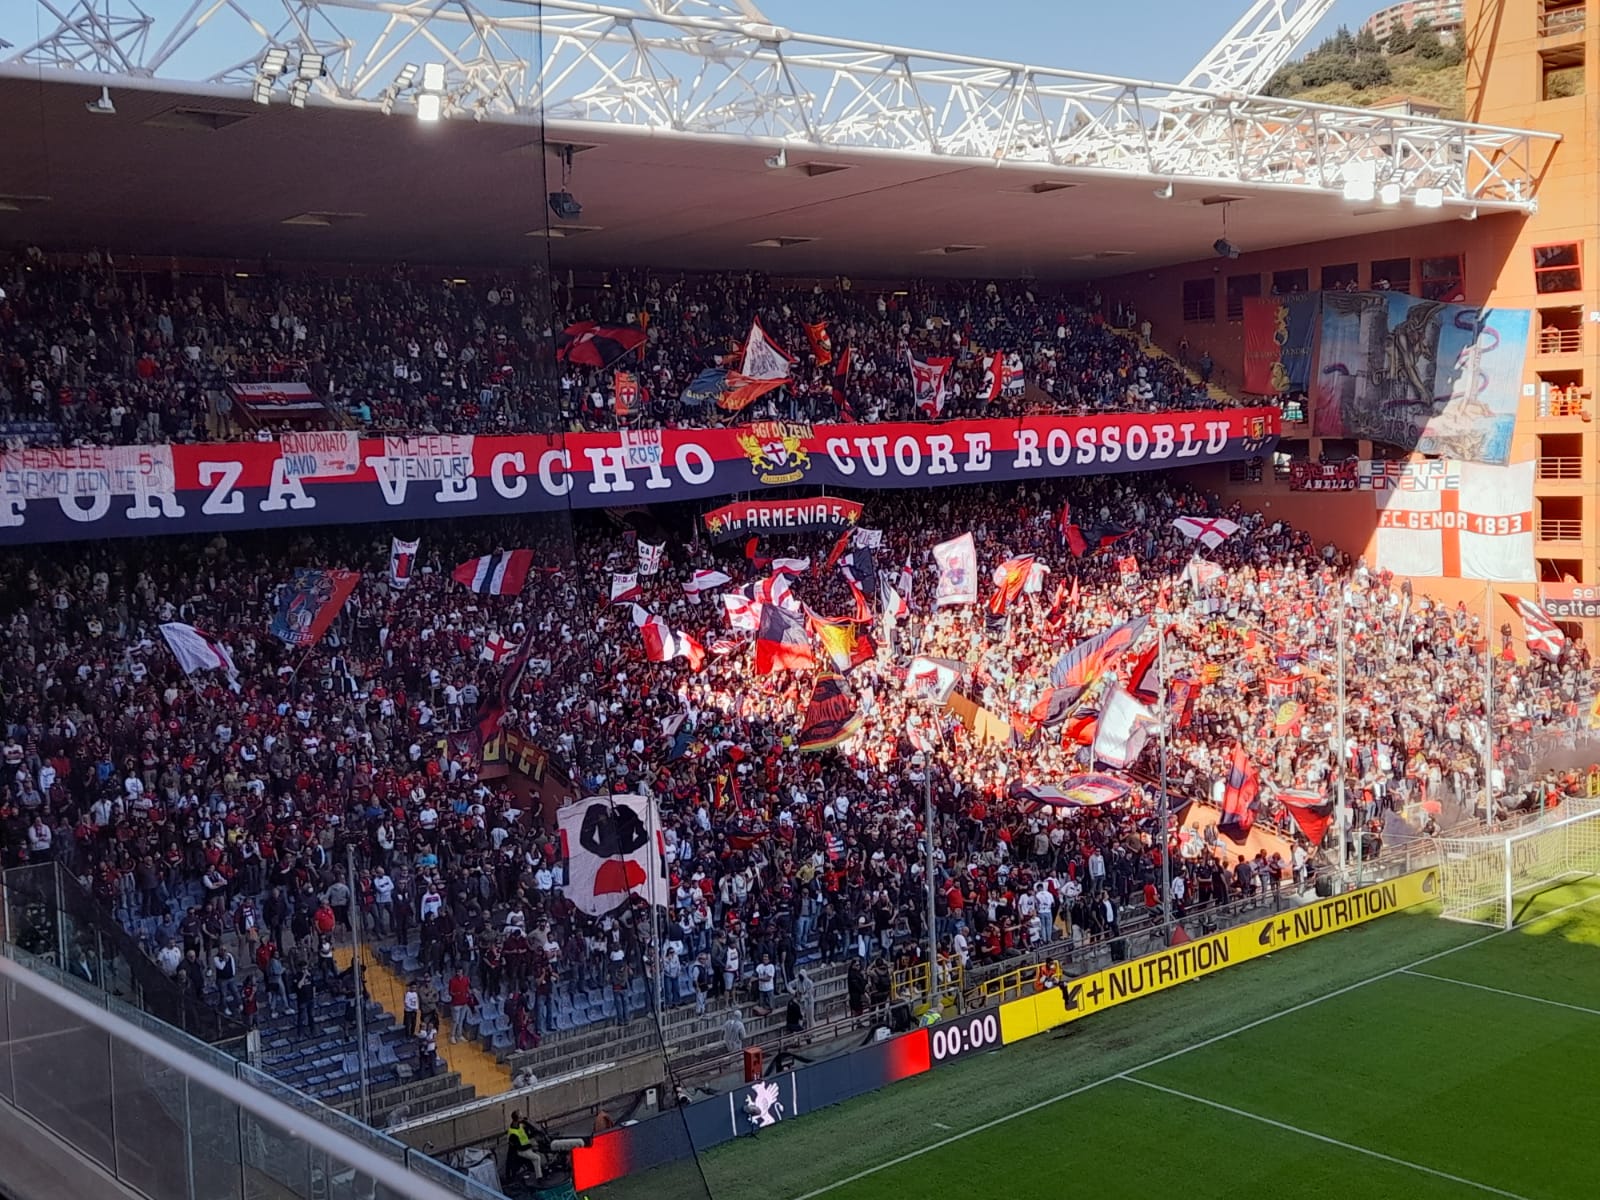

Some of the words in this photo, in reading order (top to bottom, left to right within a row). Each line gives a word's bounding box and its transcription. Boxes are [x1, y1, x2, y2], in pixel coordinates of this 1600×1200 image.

[283, 433, 347, 453] BENTORNATO
[388, 435, 461, 456] MICHELE
[825, 431, 992, 477] CUORE
[1013, 420, 1231, 468] ROSSOBLU
[285, 454, 317, 475] DAVID
[1371, 461, 1448, 476] SESTRI
[1358, 475, 1459, 489] PONENTE
[746, 504, 827, 528] ARMENIA
[1408, 511, 1468, 530] GENOA
[1475, 515, 1522, 534] 1893
[1294, 884, 1397, 939] NUTRITION
[1109, 936, 1229, 1001] NUTRITION
[933, 1014, 997, 1060] 00:00
